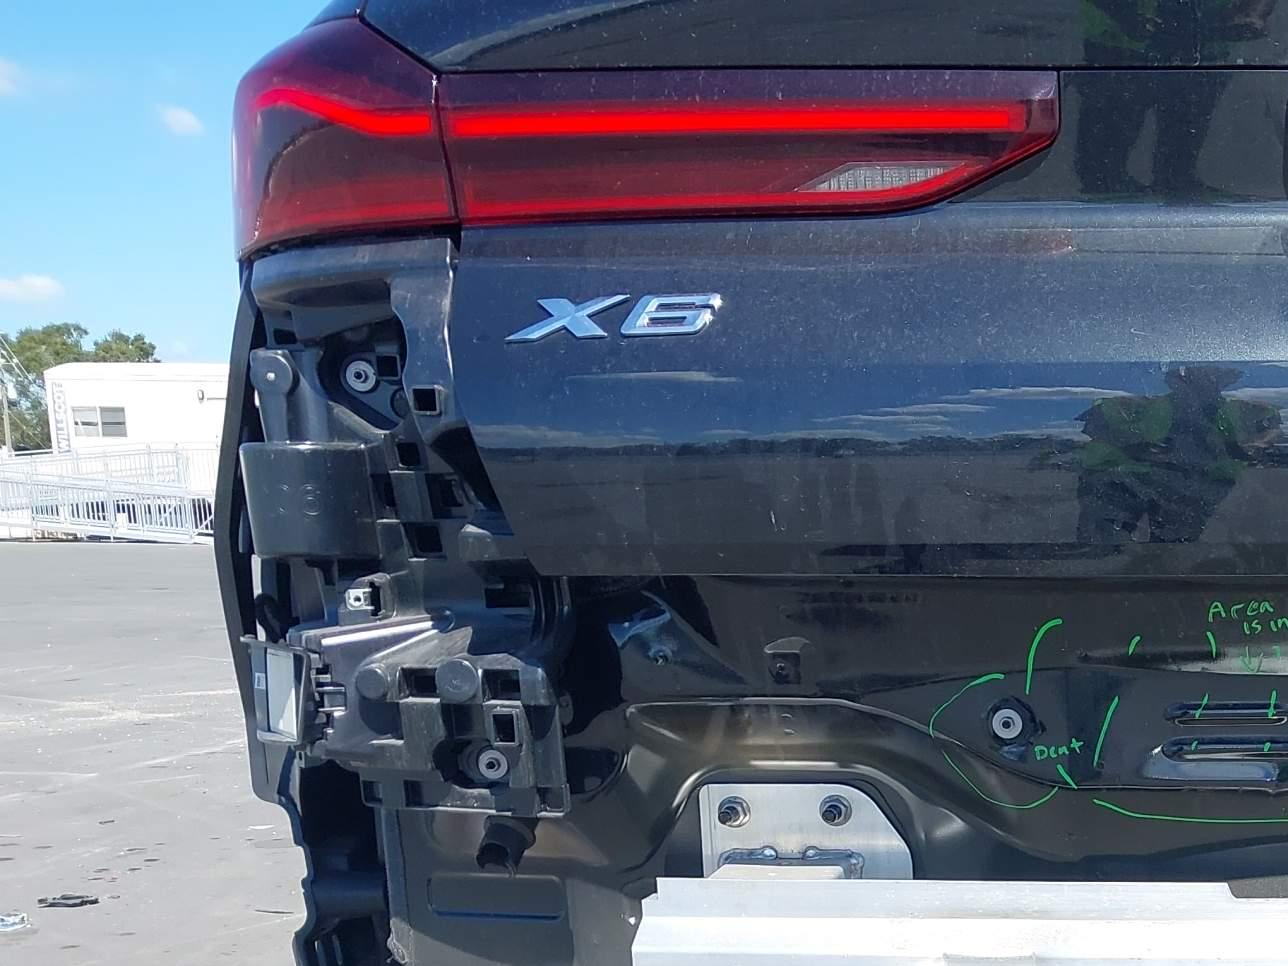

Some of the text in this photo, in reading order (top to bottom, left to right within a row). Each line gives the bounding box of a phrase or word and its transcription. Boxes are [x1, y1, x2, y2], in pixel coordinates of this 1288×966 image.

[504, 293, 722, 343] X6
[1208, 600, 1274, 622] Area
[1034, 737, 1084, 760] Dent
